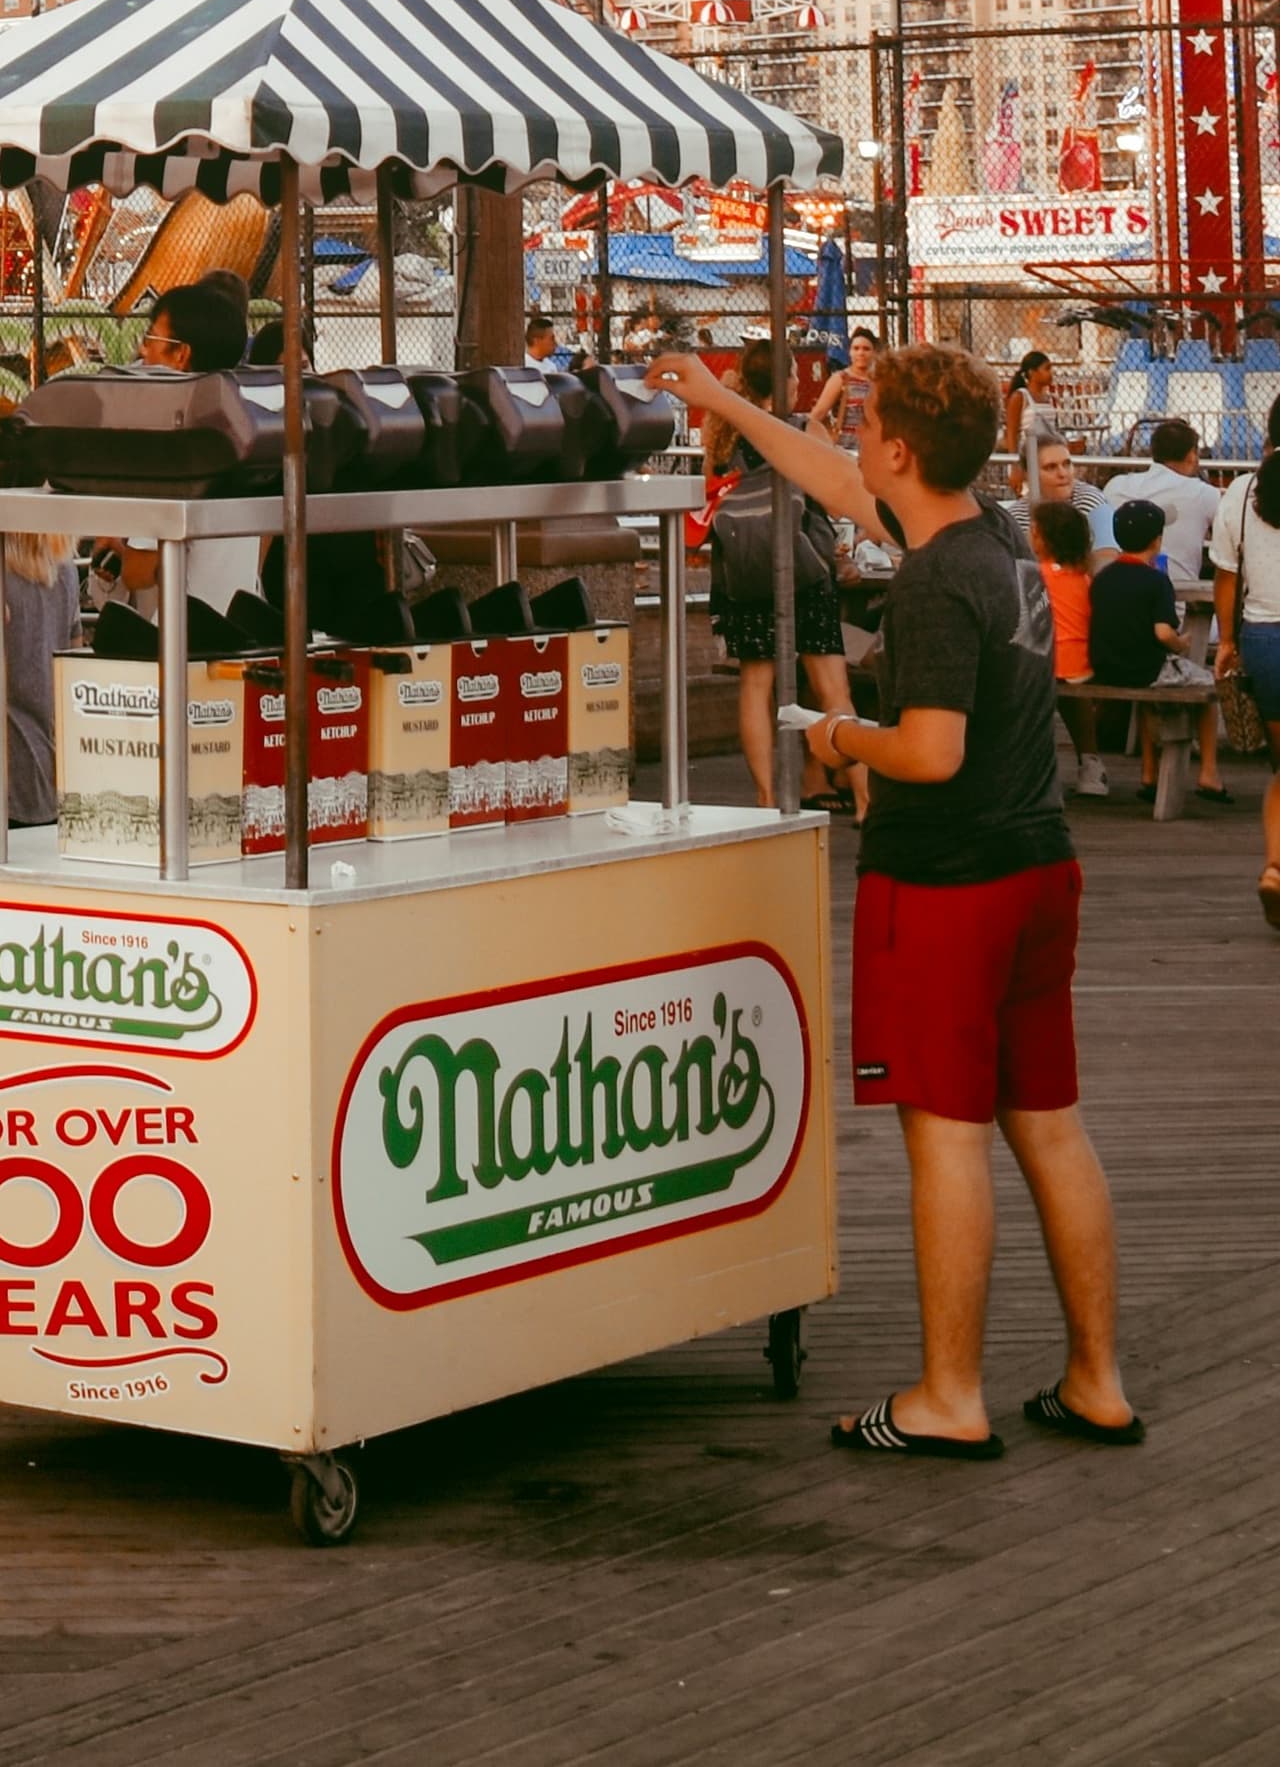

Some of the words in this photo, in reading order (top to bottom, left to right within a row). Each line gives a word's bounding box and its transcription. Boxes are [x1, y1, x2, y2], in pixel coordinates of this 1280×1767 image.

[999, 207, 1117, 237] SWEET
[544, 259, 570, 275] EXIT
[74, 683, 159, 709] Nathan's
[586, 700, 619, 712] MUSTARD
[402, 720, 439, 732] MUSTARD
[461, 712, 496, 727] KETCHUP
[523, 708, 558, 722] KETCHUP
[320, 725, 357, 740] KETCHUP
[80, 737, 159, 759] MUSTARD
[191, 741, 230, 754] MUSTARD
[81, 930, 117, 946] Since
[120, 934, 149, 949] 1916
[10, 1007, 114, 1031] FAMOUS
[614, 1006, 656, 1037] Since
[660, 997, 693, 1028] 1916
[378, 991, 762, 1204] Nathan's
[55, 1106, 199, 1145] OVER
[527, 1181, 655, 1235] FAMOUS
[68, 1381, 121, 1400] Since
[124, 1376, 168, 1399] 1916
